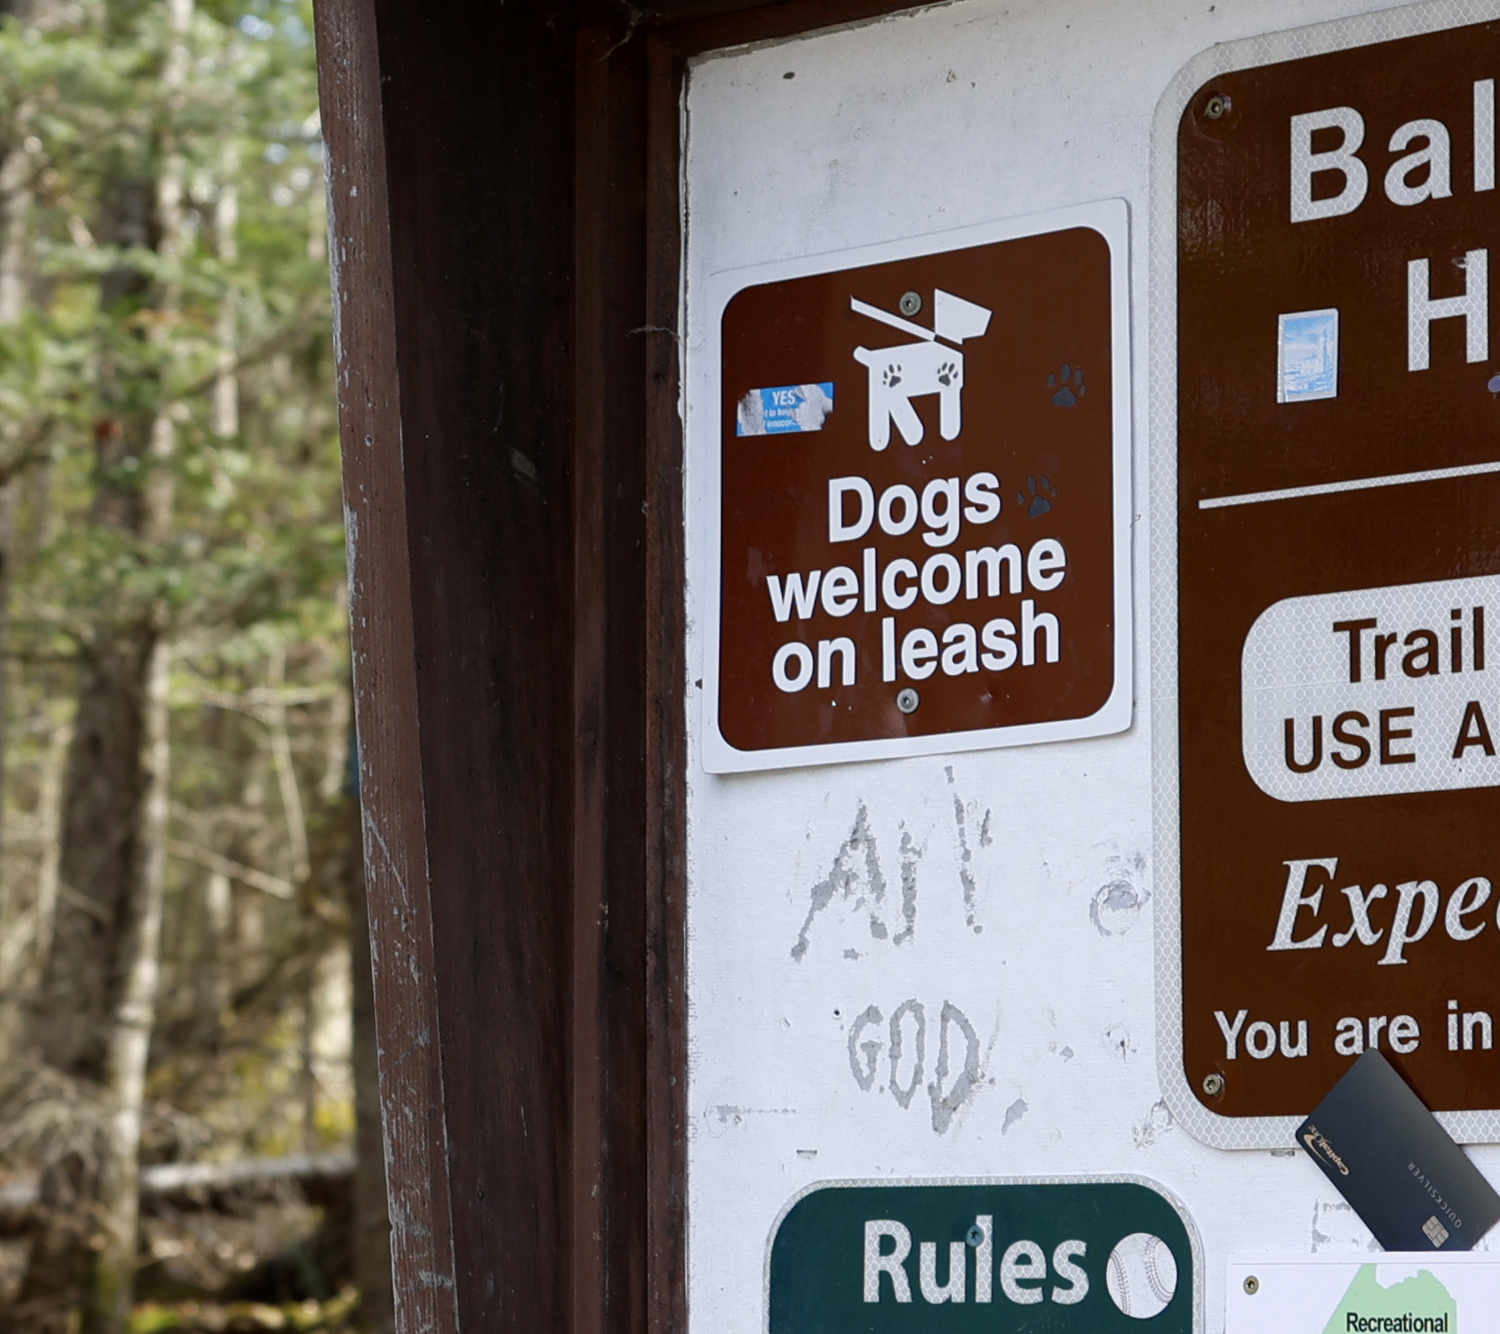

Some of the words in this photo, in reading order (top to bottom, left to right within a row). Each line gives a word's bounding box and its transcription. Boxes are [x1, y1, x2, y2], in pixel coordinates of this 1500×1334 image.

[829, 473, 1000, 547] Dogs
[767, 539, 1065, 621] welcome
[773, 638, 855, 692] on
[883, 600, 1058, 681] leash
[1333, 606, 1484, 683] Trail
[1284, 707, 1415, 773] USE
[1214, 1010, 1307, 1059] You
[1335, 1015, 1419, 1055] are
[1448, 1000, 1491, 1050] in
[1408, 1162, 1462, 1228] QUICKSILVER
[864, 1215, 1089, 1304] Rules
[1347, 1312, 1447, 1332] Recreational
